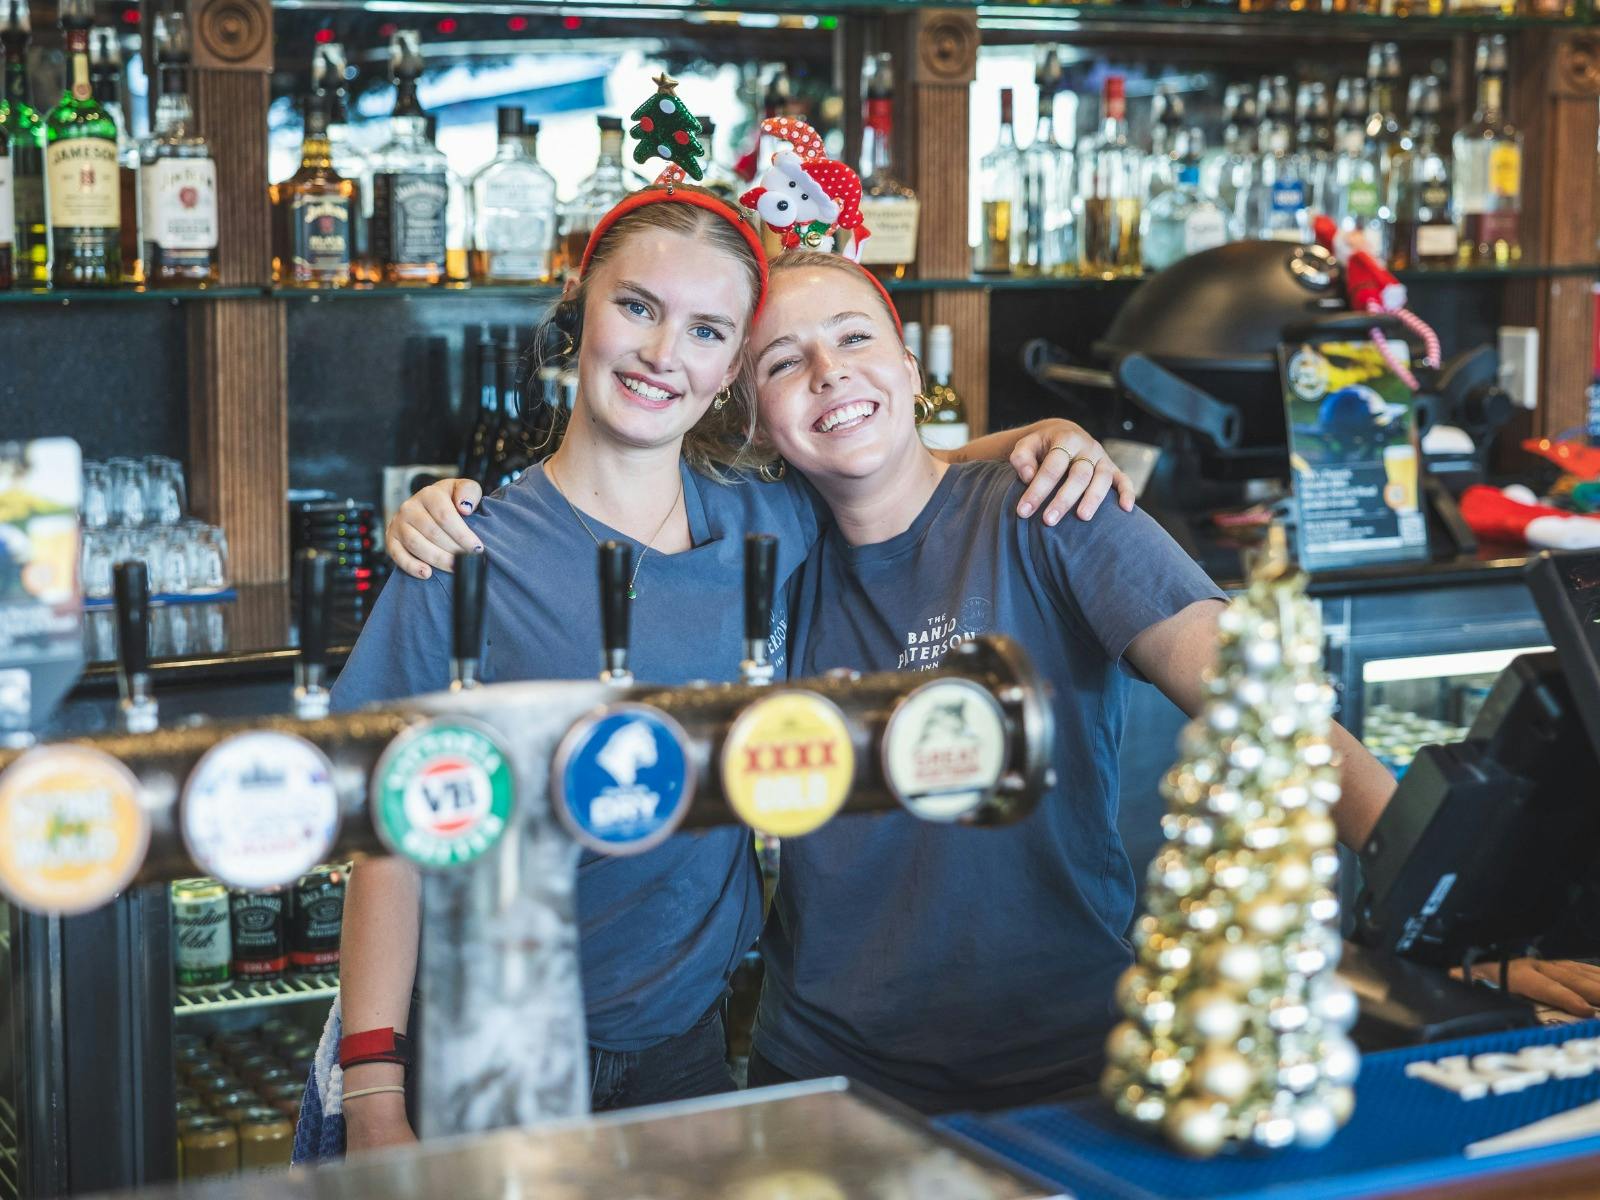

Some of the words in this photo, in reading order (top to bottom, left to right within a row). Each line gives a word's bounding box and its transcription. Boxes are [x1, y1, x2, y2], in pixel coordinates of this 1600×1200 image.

[907, 617, 957, 646] BANJO
[927, 613, 947, 626] THE
[897, 631, 976, 669] PATERSON
[920, 661, 940, 672] INN
[743, 741, 837, 775] XXXX
[423, 777, 480, 813] VB
